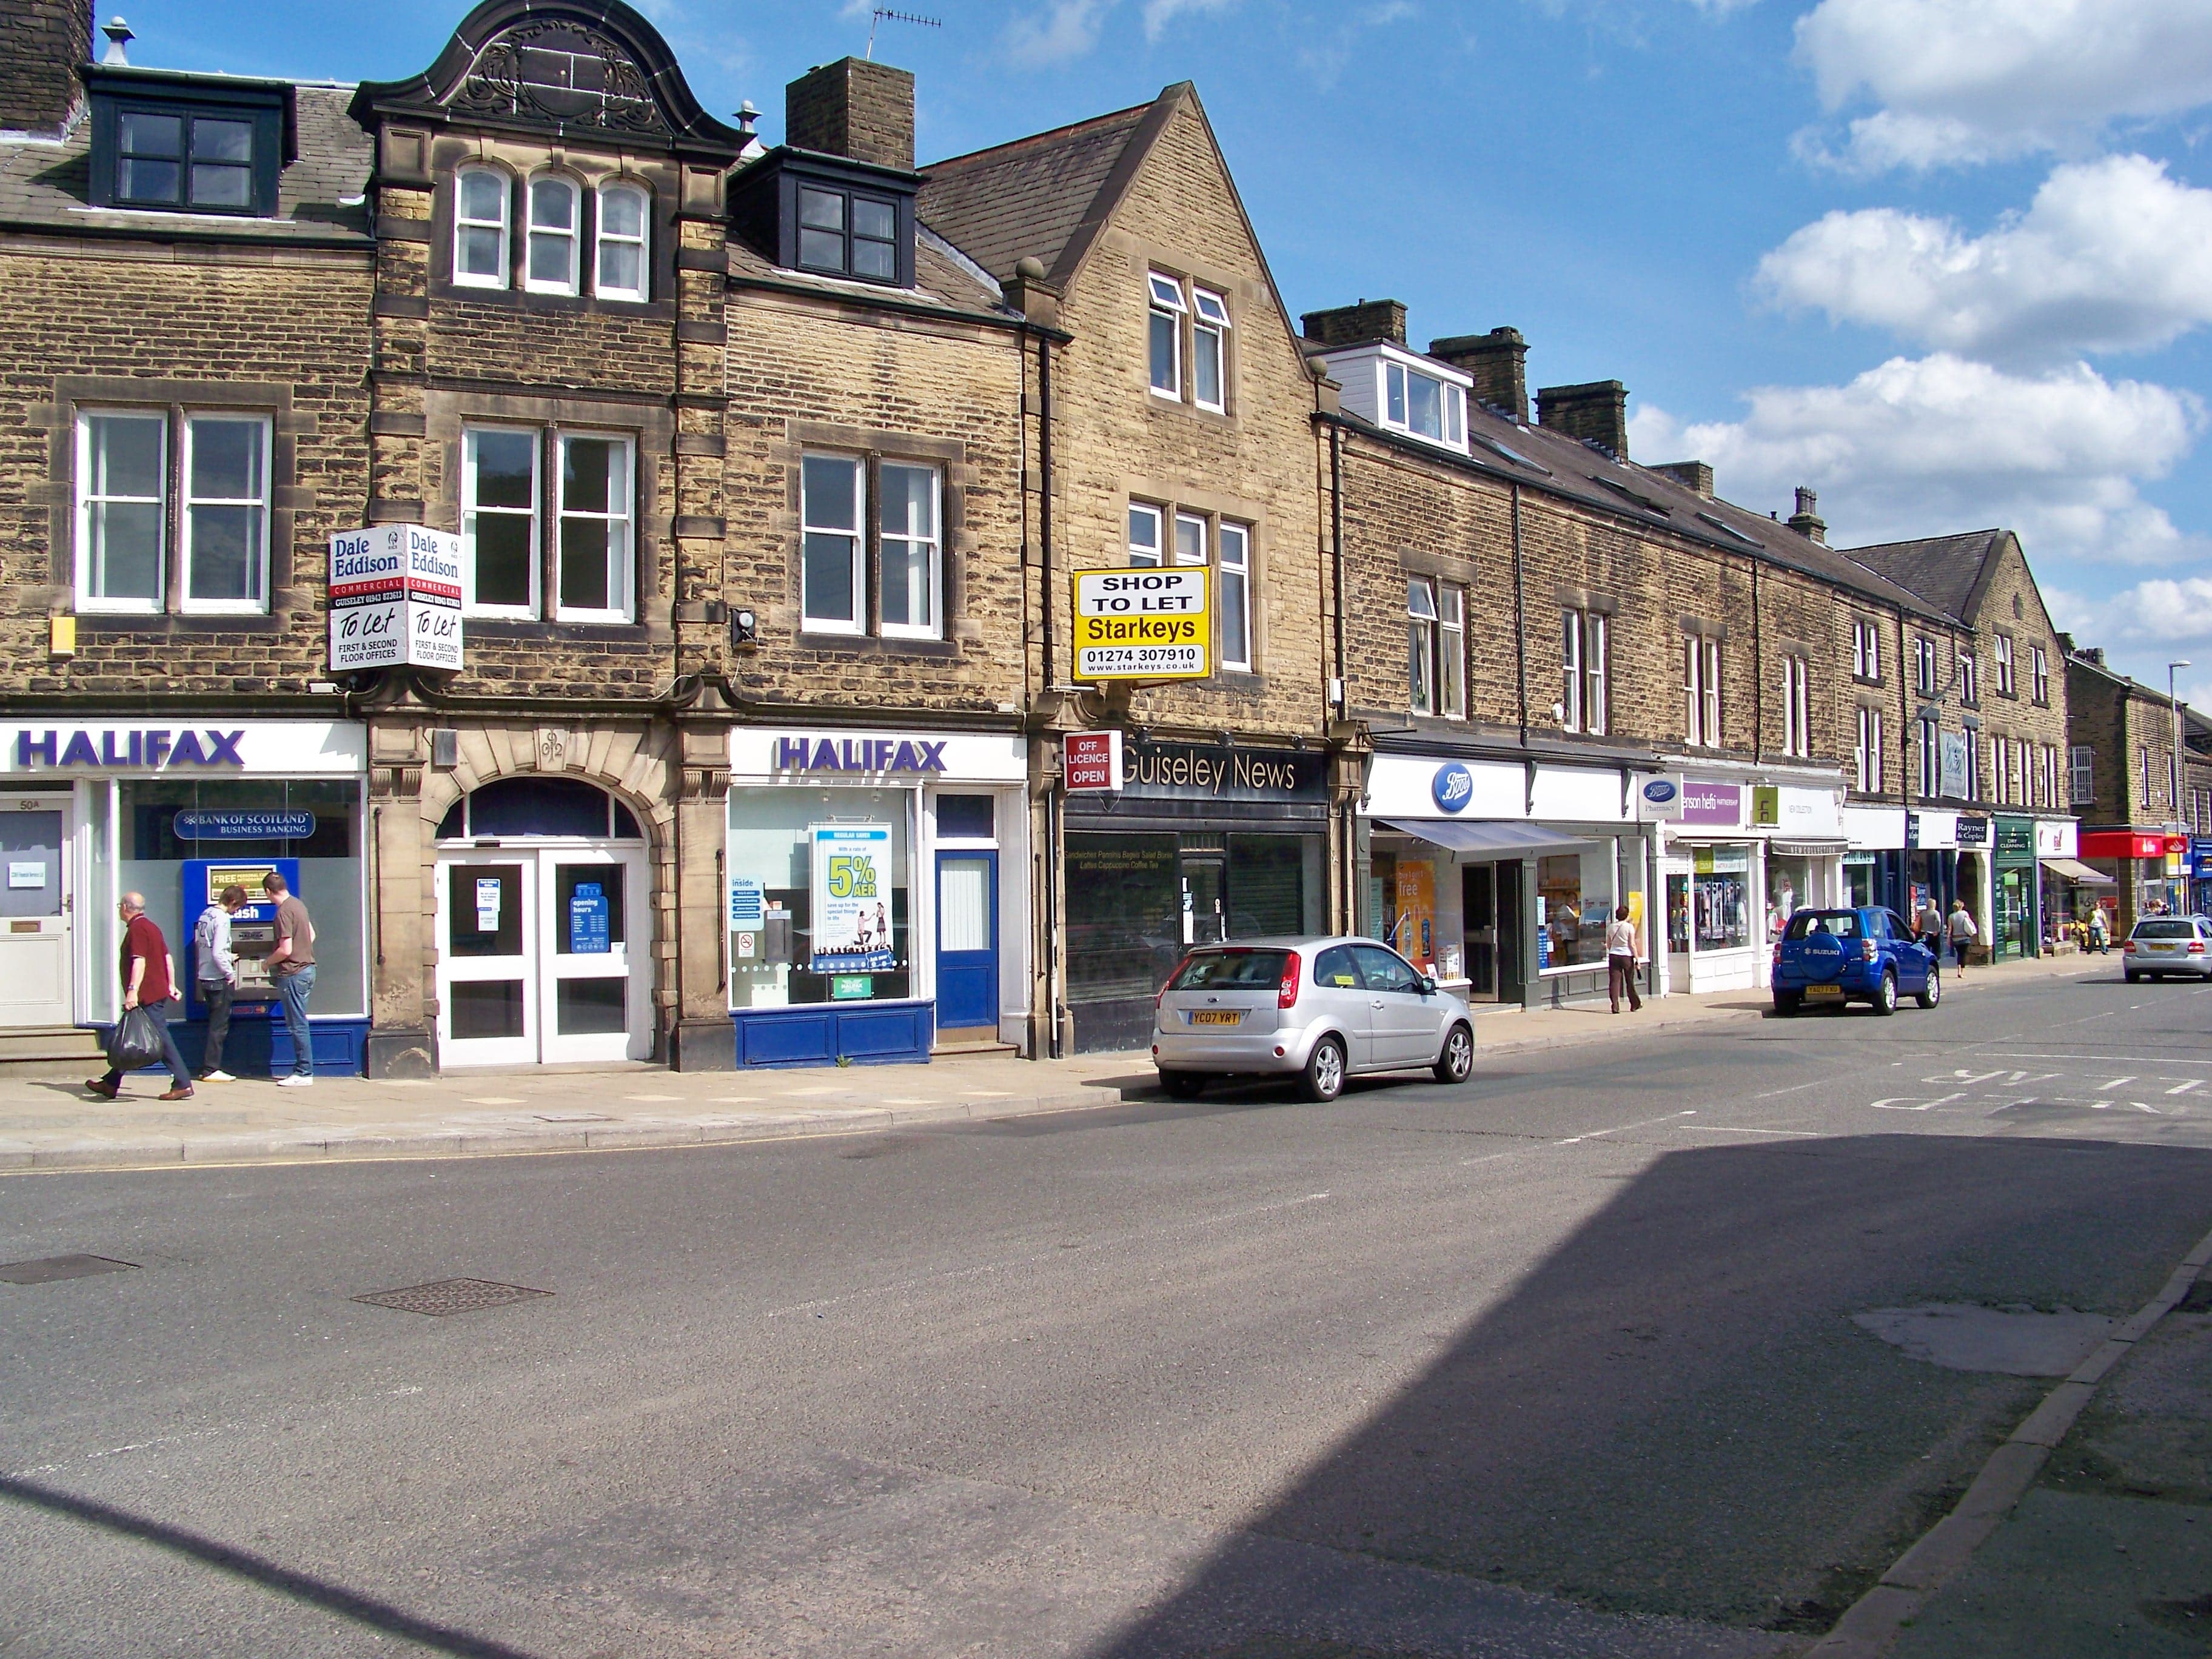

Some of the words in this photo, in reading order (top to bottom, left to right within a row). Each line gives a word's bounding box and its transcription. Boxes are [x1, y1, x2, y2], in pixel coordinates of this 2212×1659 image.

[335, 537, 369, 557] Dale
[411, 532, 437, 554] Dale
[335, 555, 398, 577] Eddison
[411, 552, 458, 578] Eddison
[335, 580, 400, 594] COMMERCIAL
[411, 579, 459, 595] COMMERCIAL
[1102, 575, 1182, 591] SHOP
[335, 595, 364, 606] GUISELEY
[1092, 597, 1130, 611] TO
[1142, 596, 1193, 610] LET
[340, 611, 360, 638] To
[417, 610, 431, 634] To
[1088, 617, 1195, 643] Starkeys
[338, 643, 360, 652] FIRST
[361, 642, 367, 651] &
[369, 639, 397, 649] SECOND
[415, 640, 431, 649] FIRST
[438, 643, 458, 654] SECOND
[341, 652, 364, 662] FLOOR
[366, 649, 396, 660] OFFICES
[417, 650, 434, 660] FLOOR
[435, 652, 457, 663] OFFICES
[1087, 650, 1133, 662] 01274
[1139, 648, 1196, 661] 307910
[1088, 661, 1195, 671] www.starkeys.co.uk
[18, 730, 246, 765] HALIFAX
[1079, 741, 1098, 751] OFF
[779, 737, 948, 771] HALIFAX
[1068, 753, 1108, 764] LICENCE
[1073, 770, 1105, 783] OPEN
[1122, 745, 1225, 795] Guiseley
[1234, 753, 1295, 789] News
[1442, 772, 1470, 800] Boots
[21, 800, 39, 810] 50A
[1702, 793, 1716, 809] hefti
[199, 815, 228, 825] BANK
[230, 815, 244, 824] OF
[247, 814, 306, 824] SCOTLAND
[1958, 823, 1985, 833] Rayner
[1803, 846, 1835, 854] COLLECTION
[213, 874, 237, 883] FREE
[829, 856, 876, 897] 5%
[852, 882, 877, 897] AER
[1398, 881, 1418, 896] free
[573, 899, 598, 907] opening
[1195, 1013, 1217, 1023] YC07
[1220, 1013, 1238, 1023] YRT
